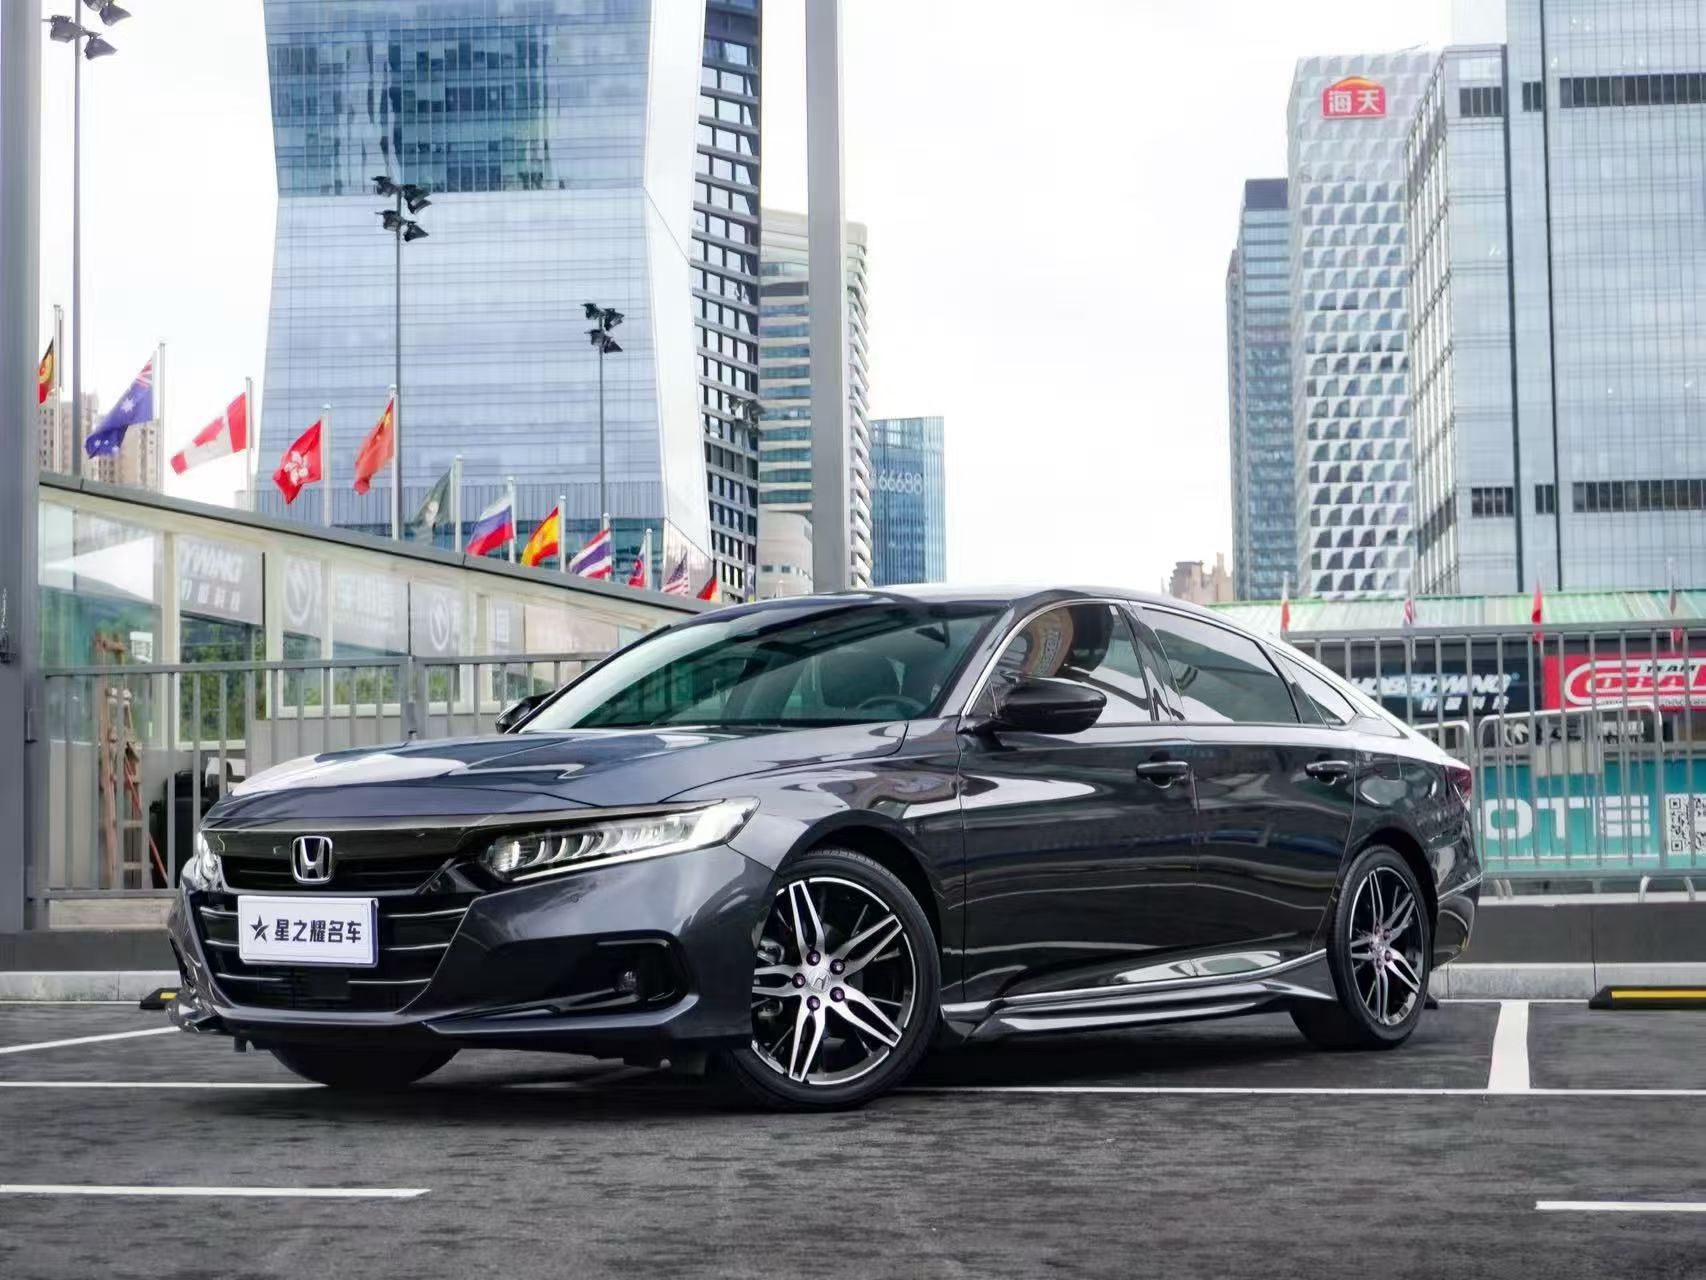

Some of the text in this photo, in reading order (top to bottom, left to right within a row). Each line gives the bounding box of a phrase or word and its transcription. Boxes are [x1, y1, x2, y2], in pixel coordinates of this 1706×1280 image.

[1327, 89, 1381, 113] 海天
[274, 918, 362, 943] 星之耀名车
